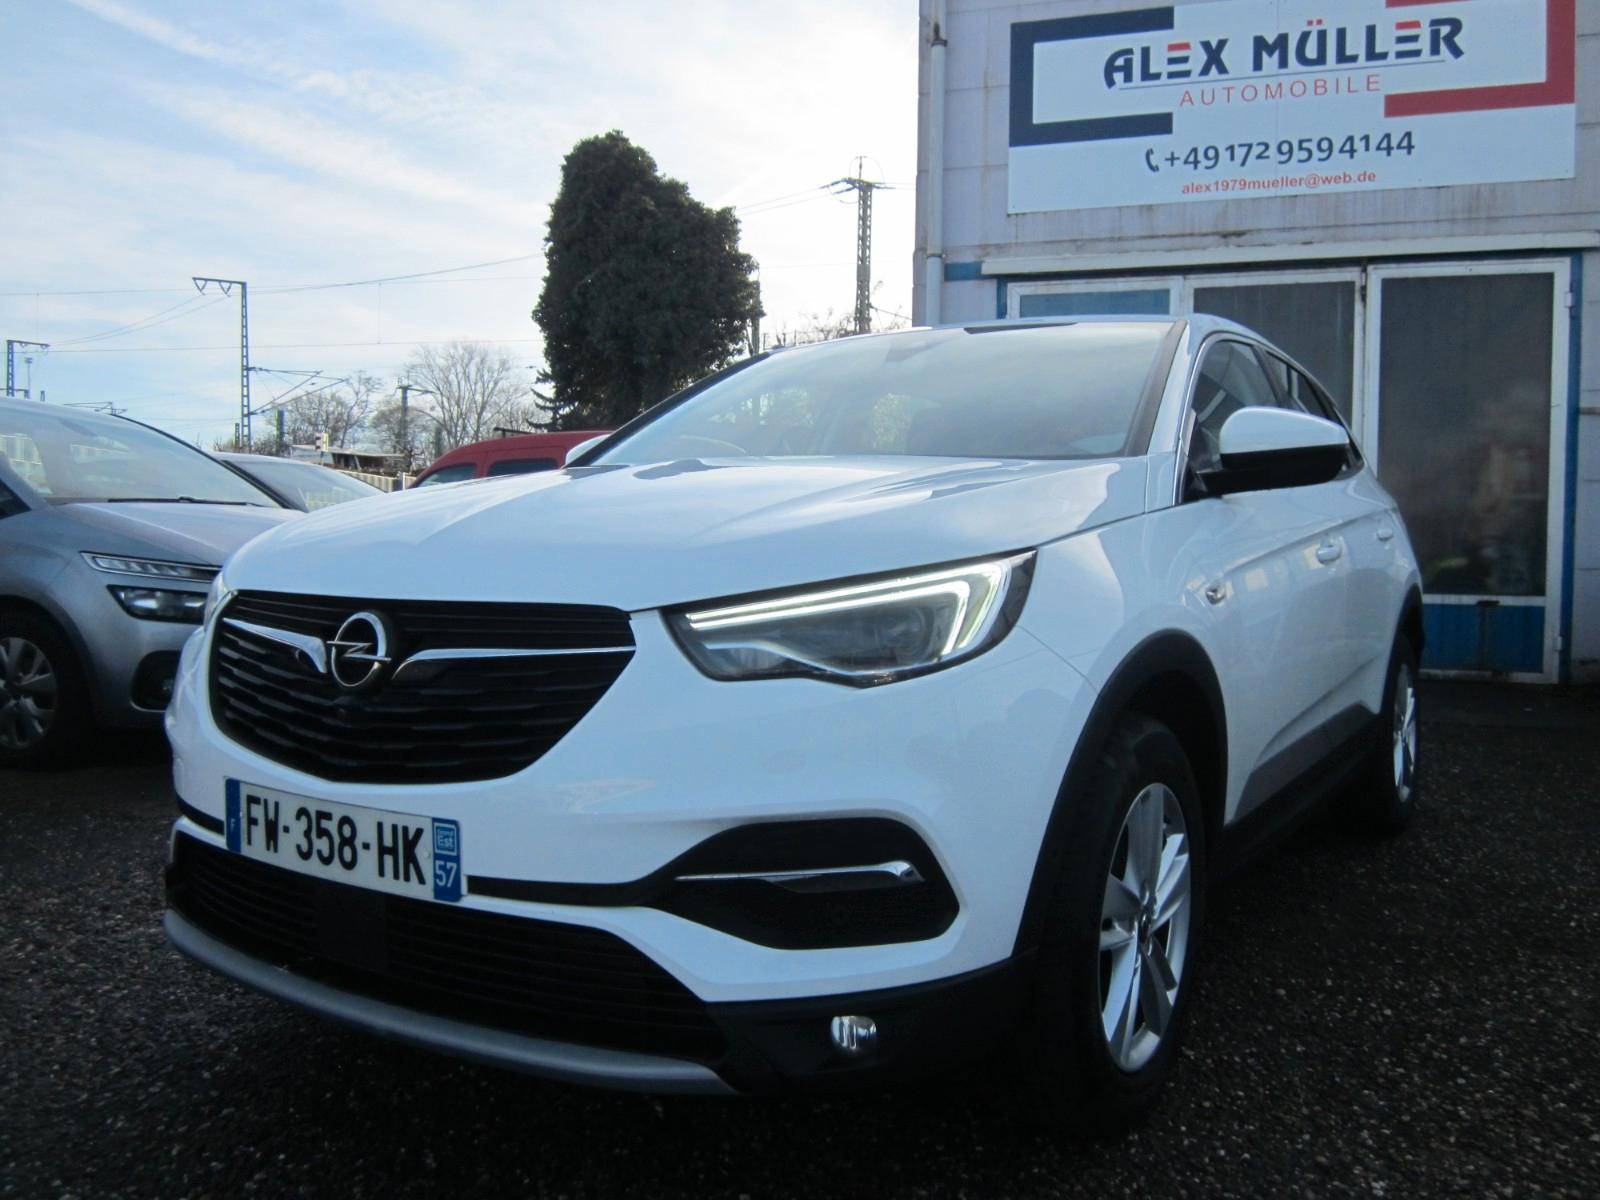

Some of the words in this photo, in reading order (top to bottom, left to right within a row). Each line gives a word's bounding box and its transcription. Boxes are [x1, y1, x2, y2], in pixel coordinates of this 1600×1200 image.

[1104, 38, 1229, 89] ALEX
[1252, 17, 1465, 73] MÜLLER
[1179, 74, 1382, 107] AUTOMOBILE
[1181, 171, 1377, 195] alex1979mueller@web.de
[246, 794, 426, 886] FW-358-HK
[435, 860, 457, 888] 57
